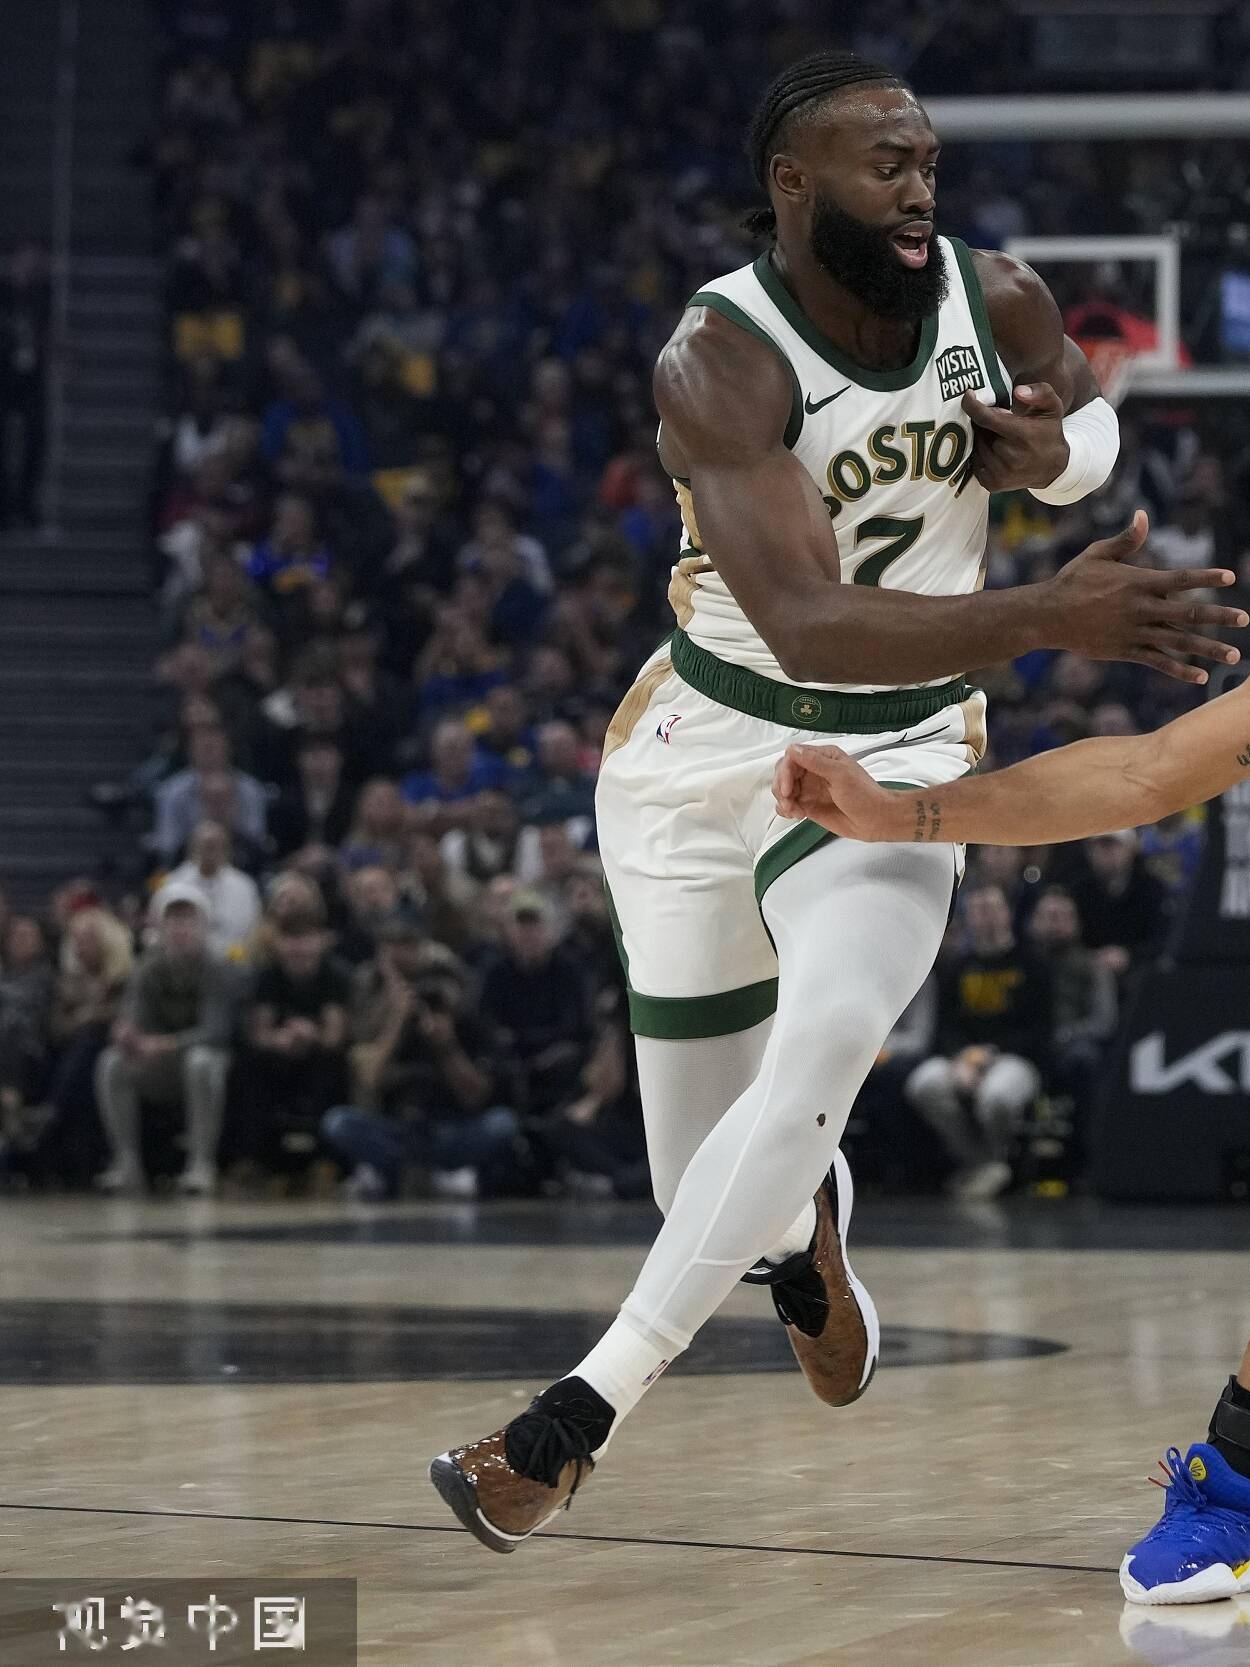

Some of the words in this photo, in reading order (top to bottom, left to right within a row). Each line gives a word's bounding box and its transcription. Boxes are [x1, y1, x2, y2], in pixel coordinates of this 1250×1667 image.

[937, 349, 978, 380] VISTA
[941, 370, 981, 399] PRINT
[822, 420, 974, 520] OSTO
[853, 512, 925, 588] 7
